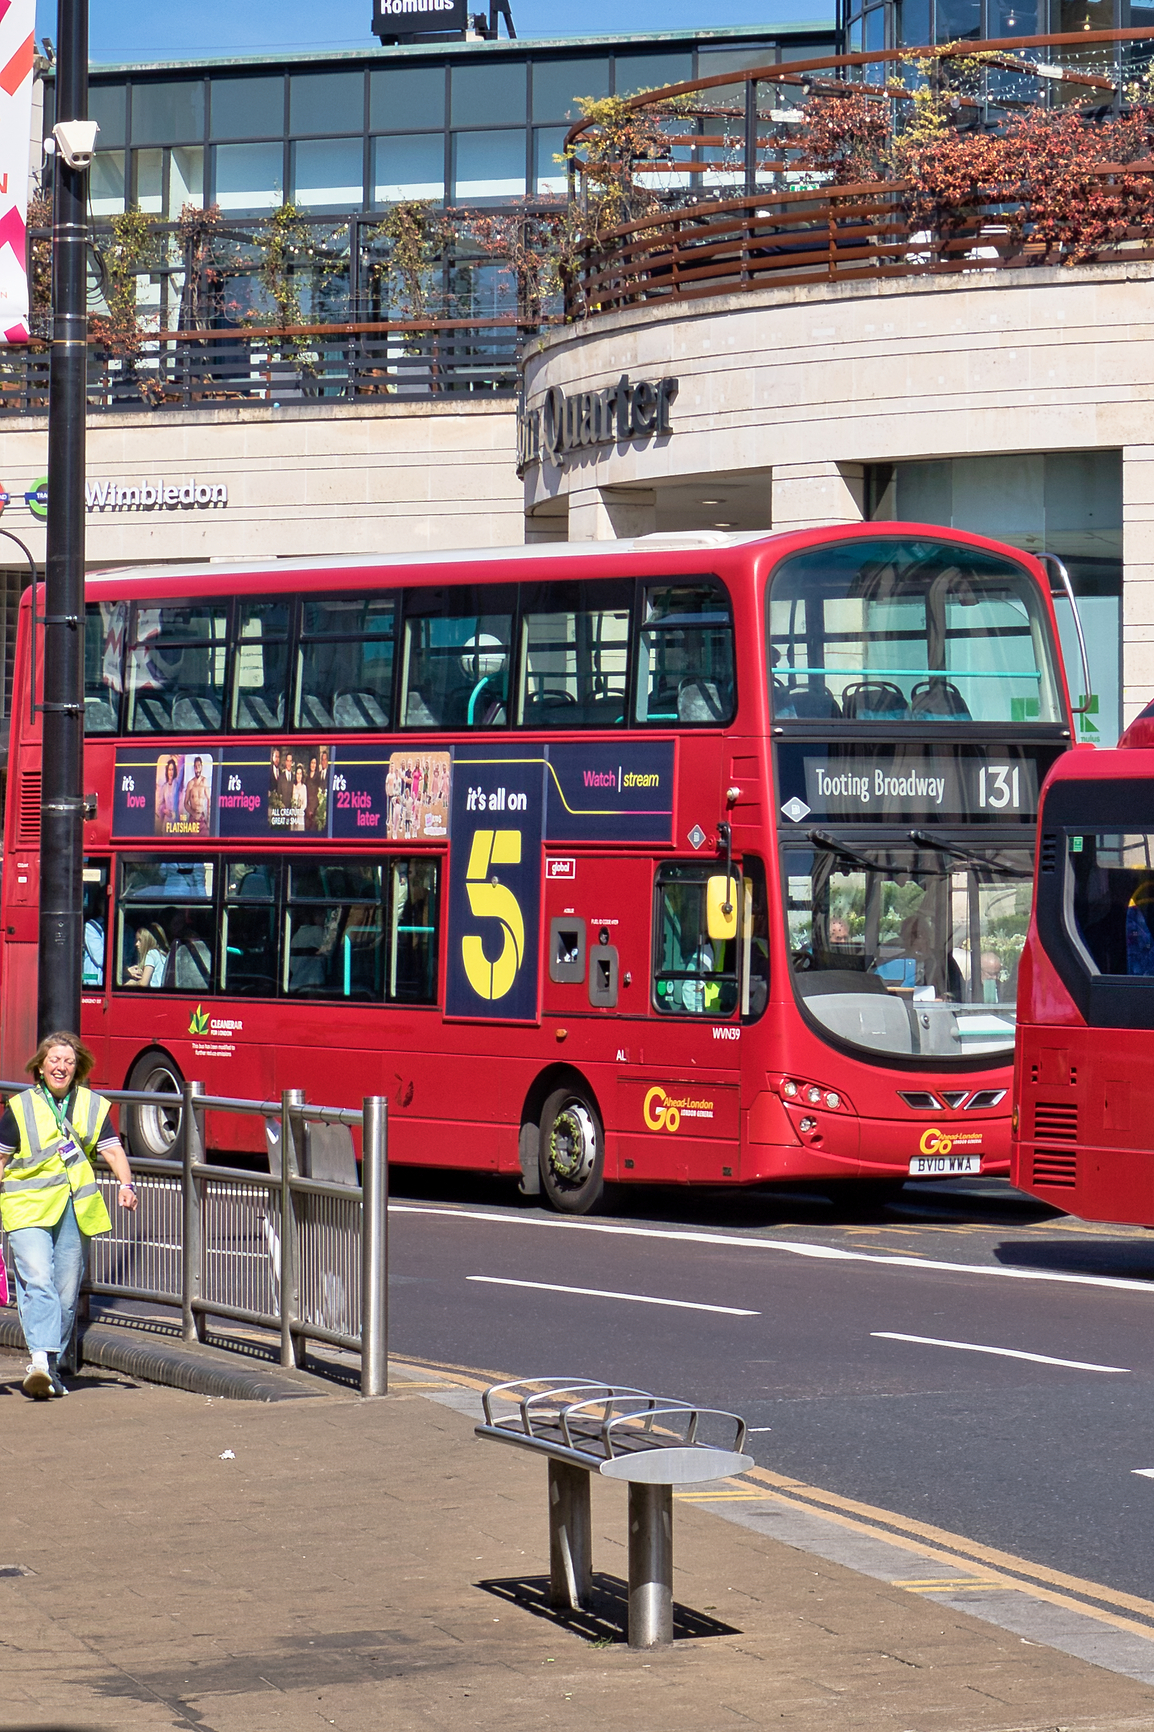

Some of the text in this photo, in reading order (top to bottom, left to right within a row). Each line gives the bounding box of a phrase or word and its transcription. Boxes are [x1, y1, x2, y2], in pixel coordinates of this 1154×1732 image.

[544, 374, 679, 467] Quarter
[86, 479, 228, 506] Wimbledon
[122, 776, 135, 792] it's
[228, 775, 242, 790] it's
[332, 774, 346, 790] it's
[584, 770, 616, 786] Watch
[624, 772, 659, 786] stream
[816, 768, 945, 804] Tooting Broadway
[979, 766, 1020, 808] 131
[126, 792, 146, 808] love
[218, 792, 260, 811] marriage
[337, 792, 372, 808] 22 kids
[466, 786, 527, 810] it's all on
[272, 817, 285, 825] GREAT
[356, 810, 380, 826] later
[166, 822, 200, 833] FLATSHARE
[552, 862, 570, 875] global
[462, 830, 525, 1000] 5
[712, 1028, 740, 1040] WVN39
[616, 1050, 626, 1060] AL
[644, 1086, 714, 1132] Go Ahead-London
[920, 1128, 952, 1154] Go
[918, 1156, 972, 1172] BV10 WWA
